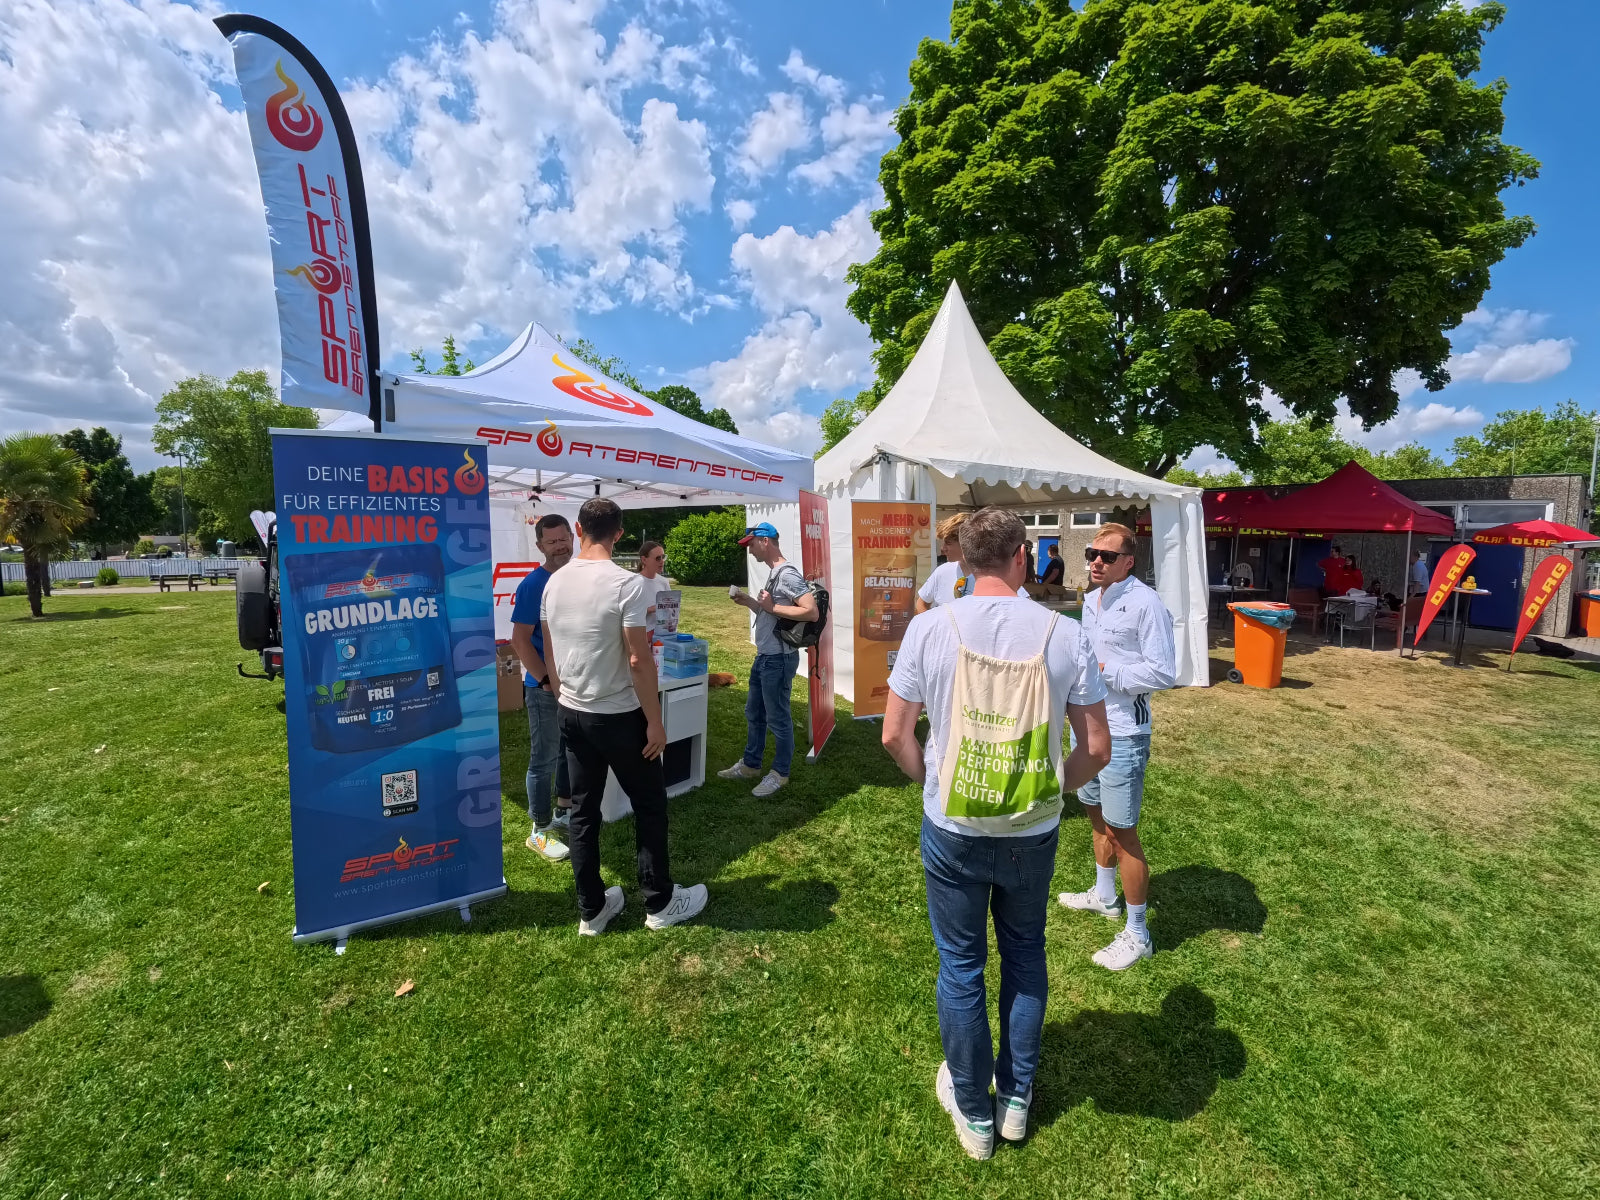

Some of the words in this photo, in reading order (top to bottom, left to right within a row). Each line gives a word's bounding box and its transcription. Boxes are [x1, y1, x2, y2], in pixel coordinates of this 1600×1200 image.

[297, 163, 349, 387] SPORT
[308, 466, 364, 482] DEINE
[367, 464, 449, 494] BASIS
[283, 493, 320, 510] FÜR
[327, 495, 440, 511] EFFIZIENTES
[290, 515, 438, 543] TRAINING
[860, 518, 880, 526] MACH
[882, 513, 914, 527] MEHR
[869, 527, 884, 535] AUS
[885, 527, 911, 536] DEINEM
[857, 535, 912, 549] TRAINING
[864, 576, 914, 588] BELASTUNG
[1430, 551, 1470, 606] DLRG
[1525, 562, 1567, 619] DLRG
[304, 596, 439, 634] GRUNDLAGE
[446, 497, 501, 828] GRUNDLAGE
[368, 686, 395, 702] FREI
[337, 713, 367, 724] NEUTRAL
[375, 709, 394, 723] 1:0
[962, 704, 1018, 727] Schnitzer
[957, 764, 989, 787] NULL
[954, 780, 1005, 805] GLUTEN
[342, 839, 460, 875] SPORT
